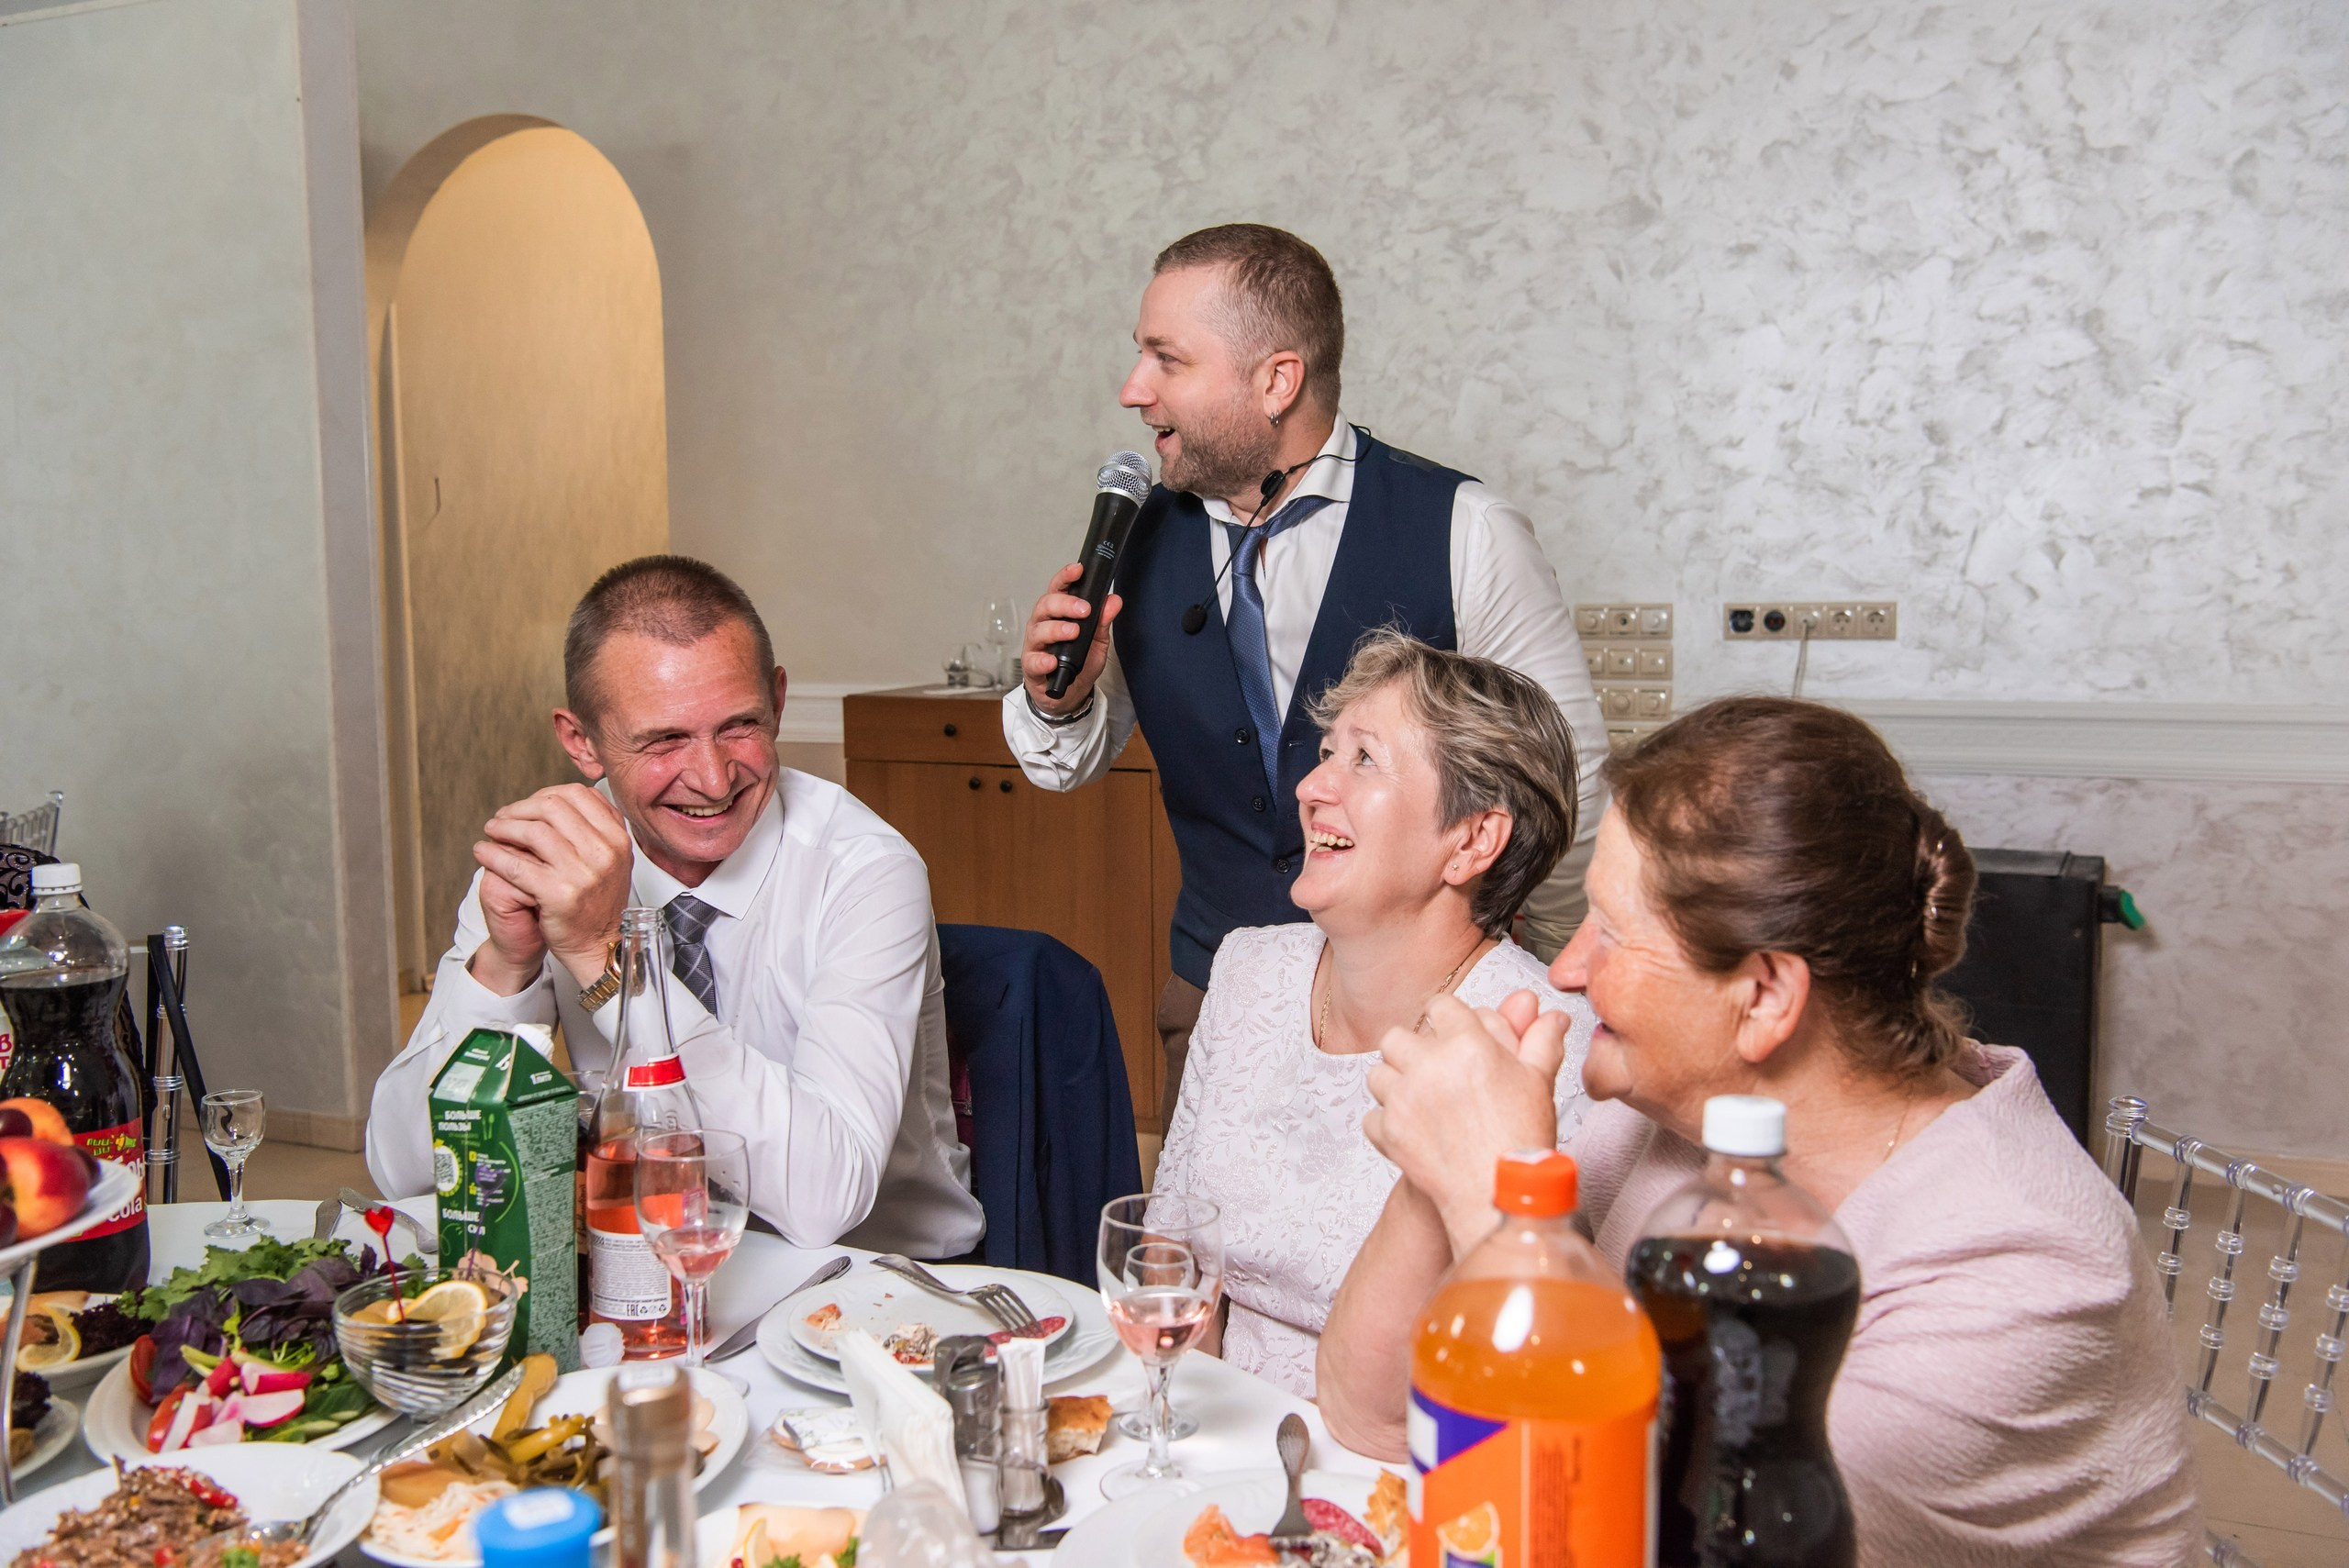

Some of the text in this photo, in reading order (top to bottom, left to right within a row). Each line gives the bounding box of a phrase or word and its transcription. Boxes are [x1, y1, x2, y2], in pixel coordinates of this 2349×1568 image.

[444, 1109, 482, 1120] БОЛЬШЕ
[438, 1121, 472, 1131] ПОЛЬЗЫ
[442, 1207, 480, 1222] БОЛЬШЕ
